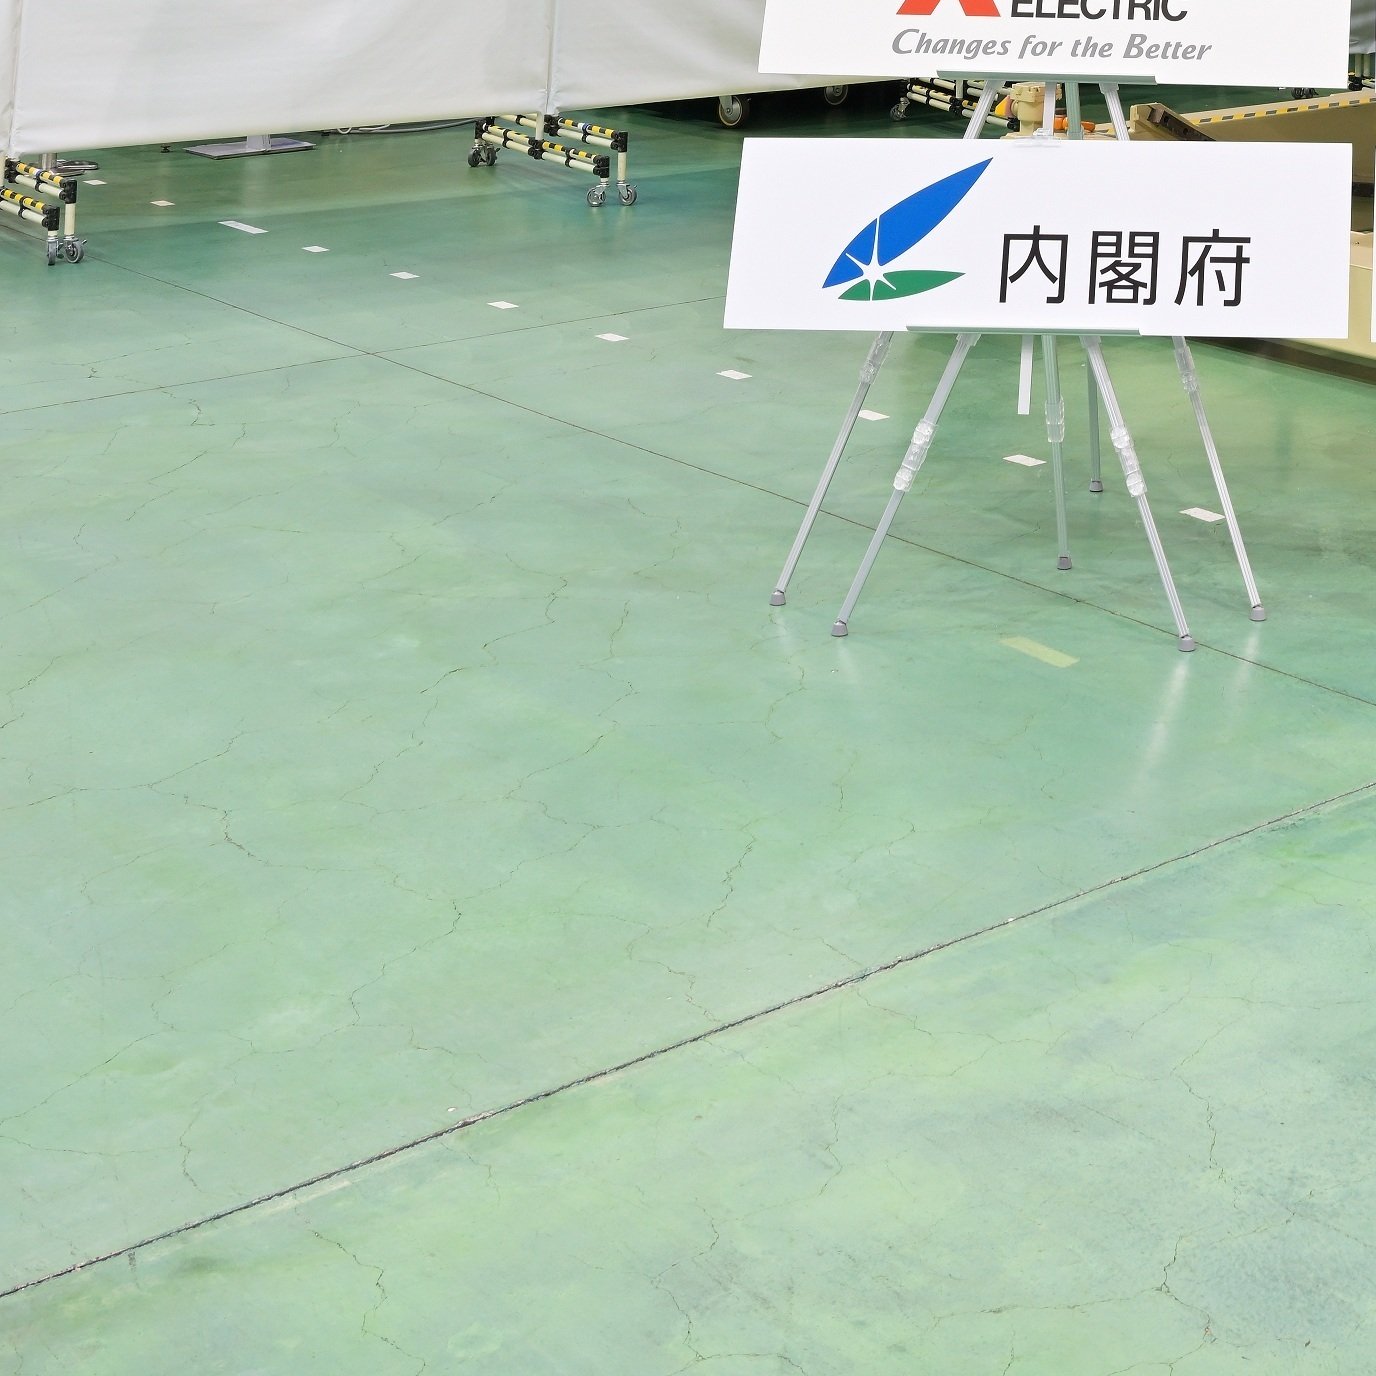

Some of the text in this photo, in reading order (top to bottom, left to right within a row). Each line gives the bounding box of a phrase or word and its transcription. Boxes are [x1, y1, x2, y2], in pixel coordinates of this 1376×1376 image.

[891, 28, 1213, 61] Changes for the Better
[999, 224, 1252, 307] 内閣府
